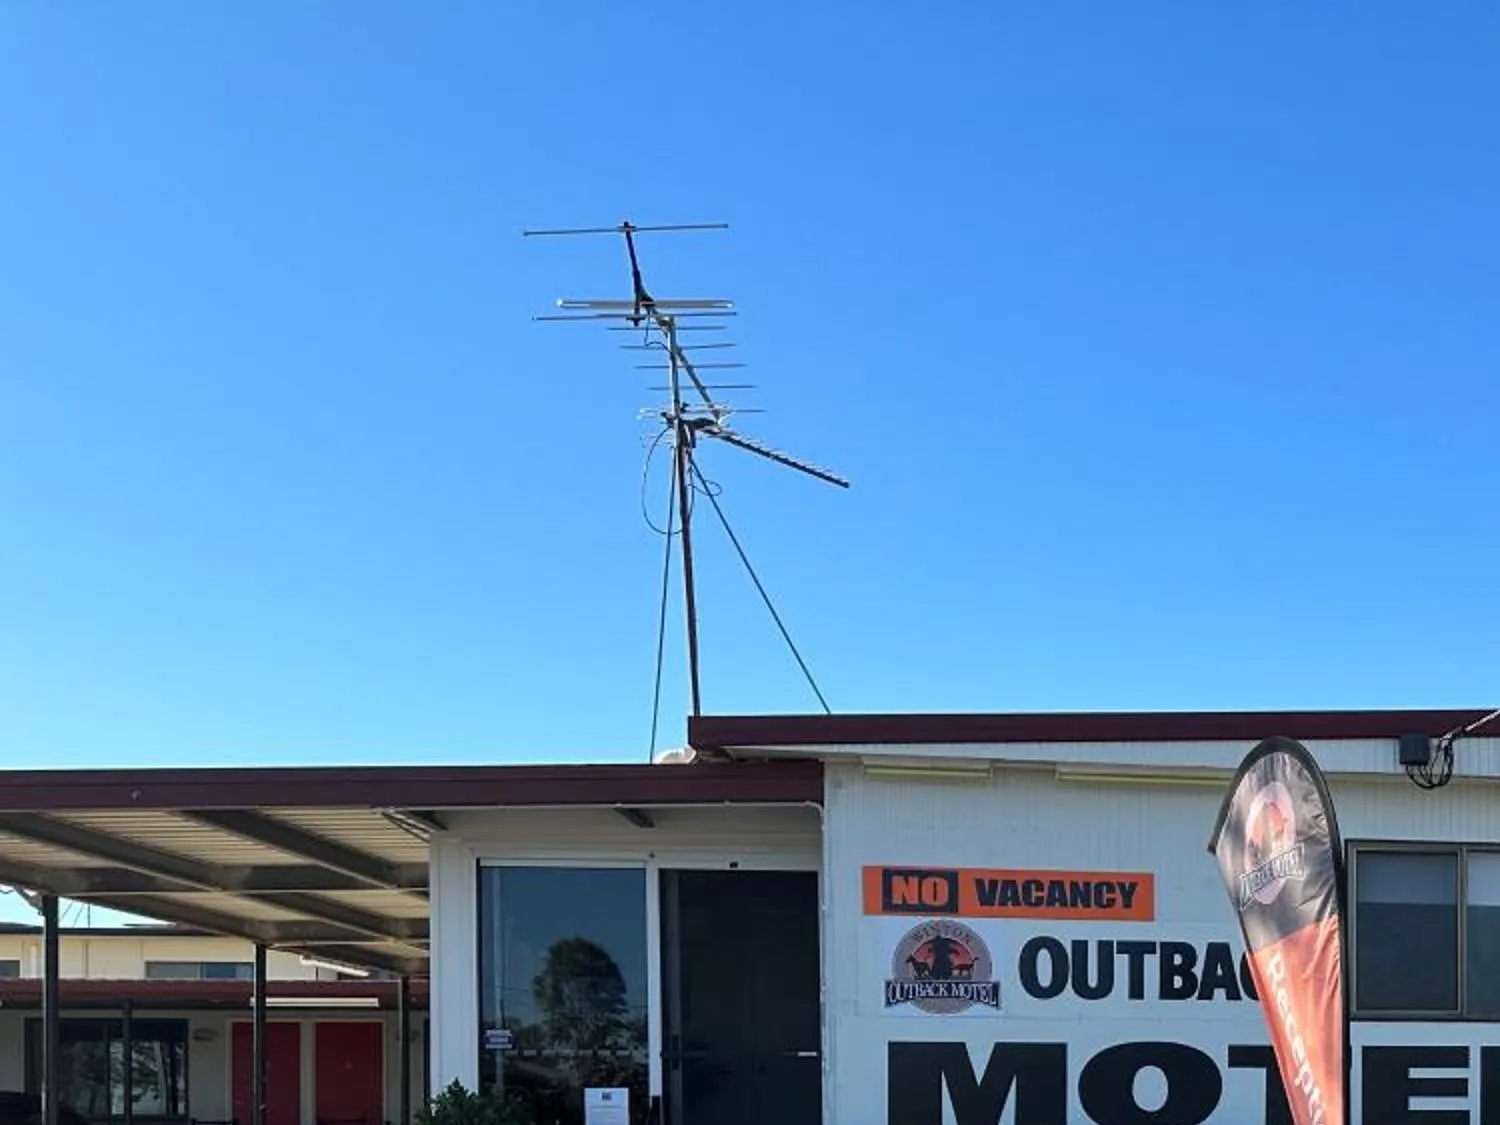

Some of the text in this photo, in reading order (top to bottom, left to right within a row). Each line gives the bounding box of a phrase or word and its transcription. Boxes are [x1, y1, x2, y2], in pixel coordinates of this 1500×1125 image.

[891, 875, 1139, 909] NO VACANCY
[888, 982, 998, 1005] OUTBACK MOTEL
